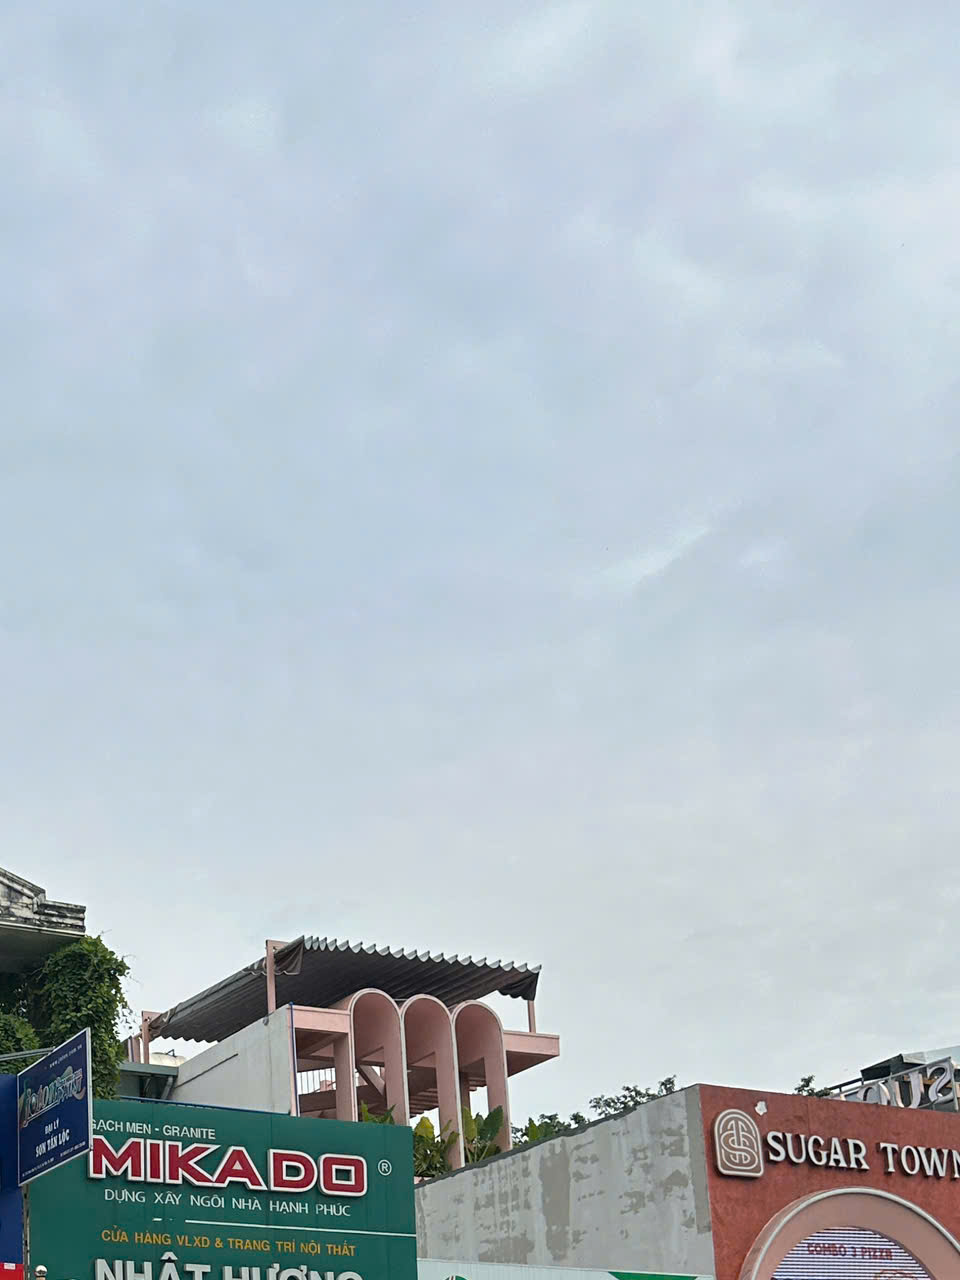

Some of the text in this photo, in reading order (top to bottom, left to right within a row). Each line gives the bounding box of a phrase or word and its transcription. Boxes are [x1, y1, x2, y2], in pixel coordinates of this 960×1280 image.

[126, 1122, 151, 1134] MEN
[163, 1125, 216, 1140] GRANITE
[88, 1135, 368, 1197] MIKADO
[767, 1130, 870, 1170] SUGAR
[104, 1188, 351, 1217] DỰNG XÂY NGÔI NHÀ HẠNH PHÚC
[101, 1224, 357, 1257] CỬA HÀNG VLXD & TRANG TRÍ NỘI THẤT
